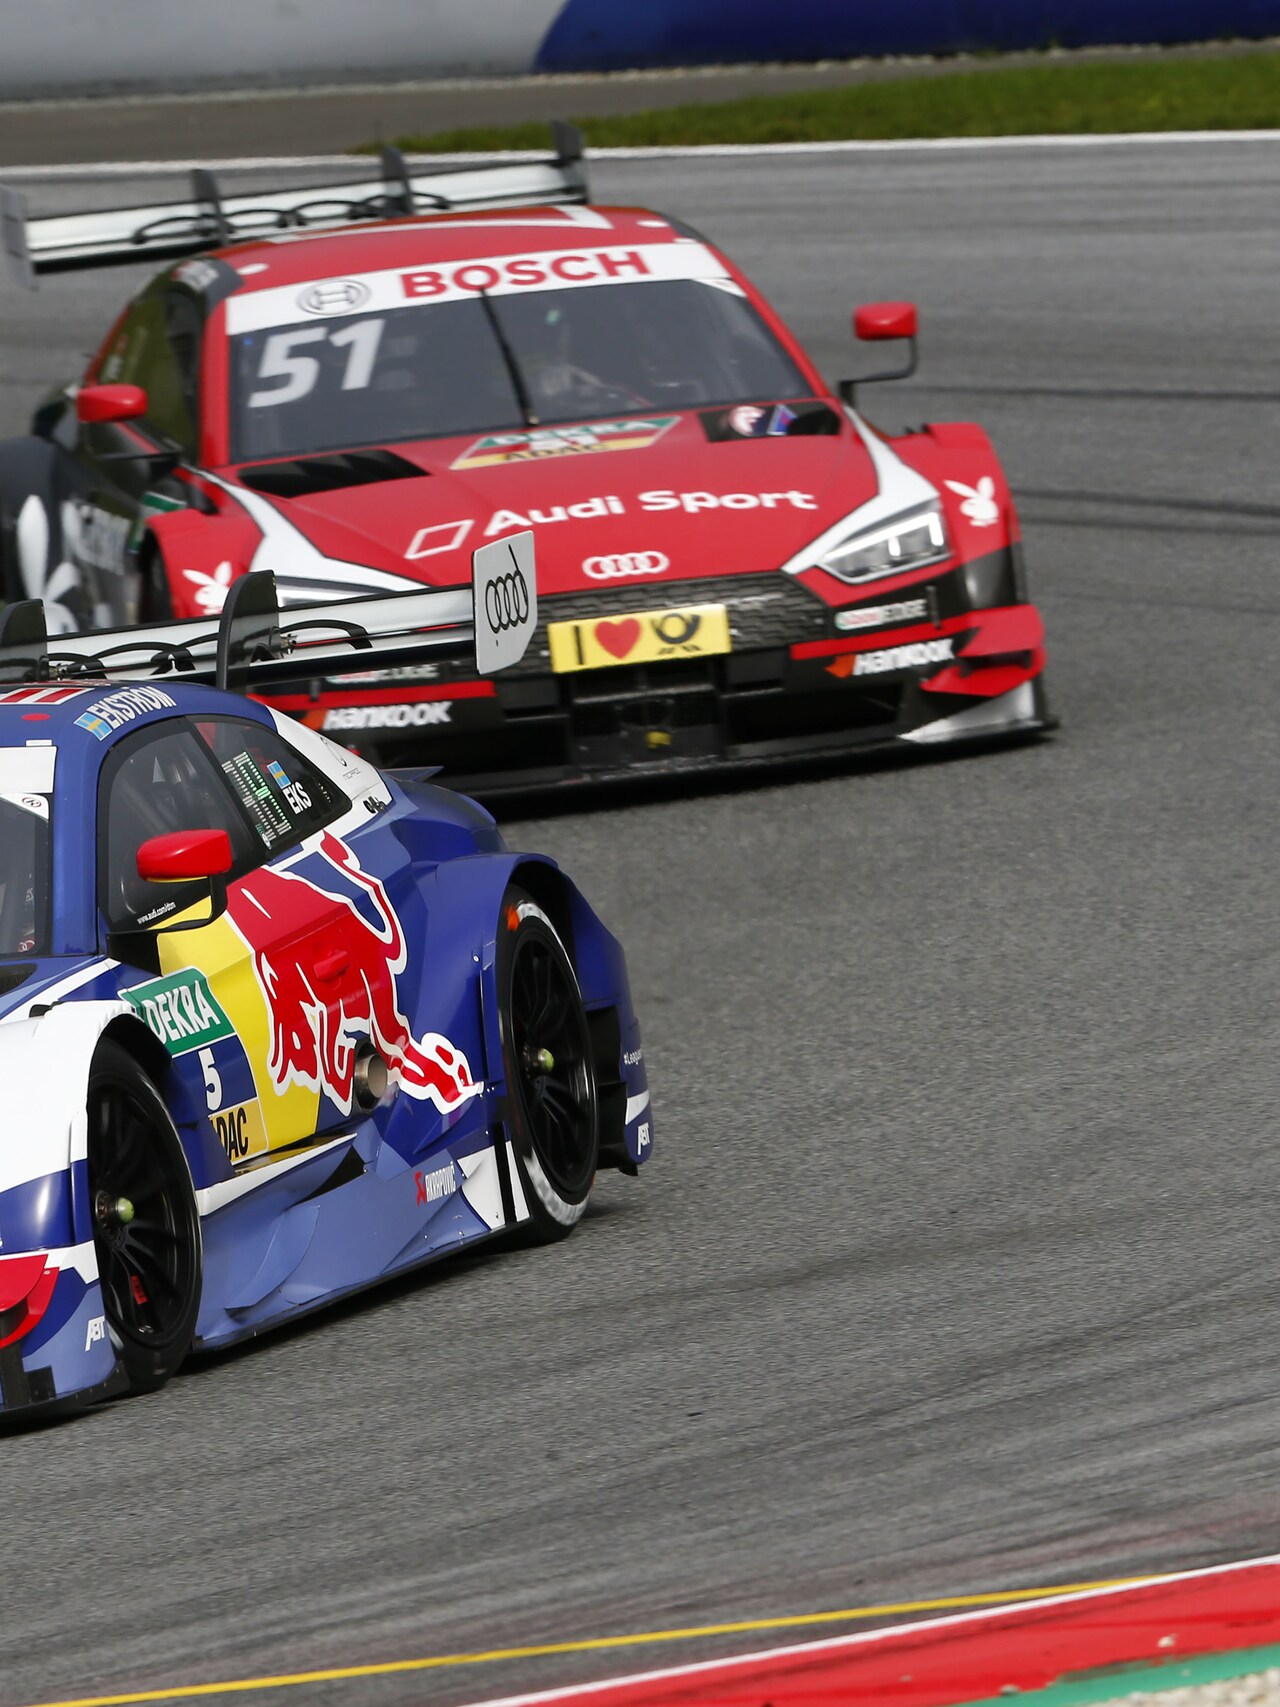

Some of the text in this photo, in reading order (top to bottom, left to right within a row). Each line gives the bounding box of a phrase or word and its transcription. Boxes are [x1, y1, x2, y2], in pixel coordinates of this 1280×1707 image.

[400, 251, 650, 299] BOSCH
[248, 318, 386, 408] 51
[484, 488, 817, 537] Audi Sport
[282, 781, 312, 814] EKS
[141, 980, 221, 1045] DEKRA
[198, 1047, 223, 1110] 5
[210, 1107, 249, 1161] DAC
[84, 1315, 105, 1352] ABT
